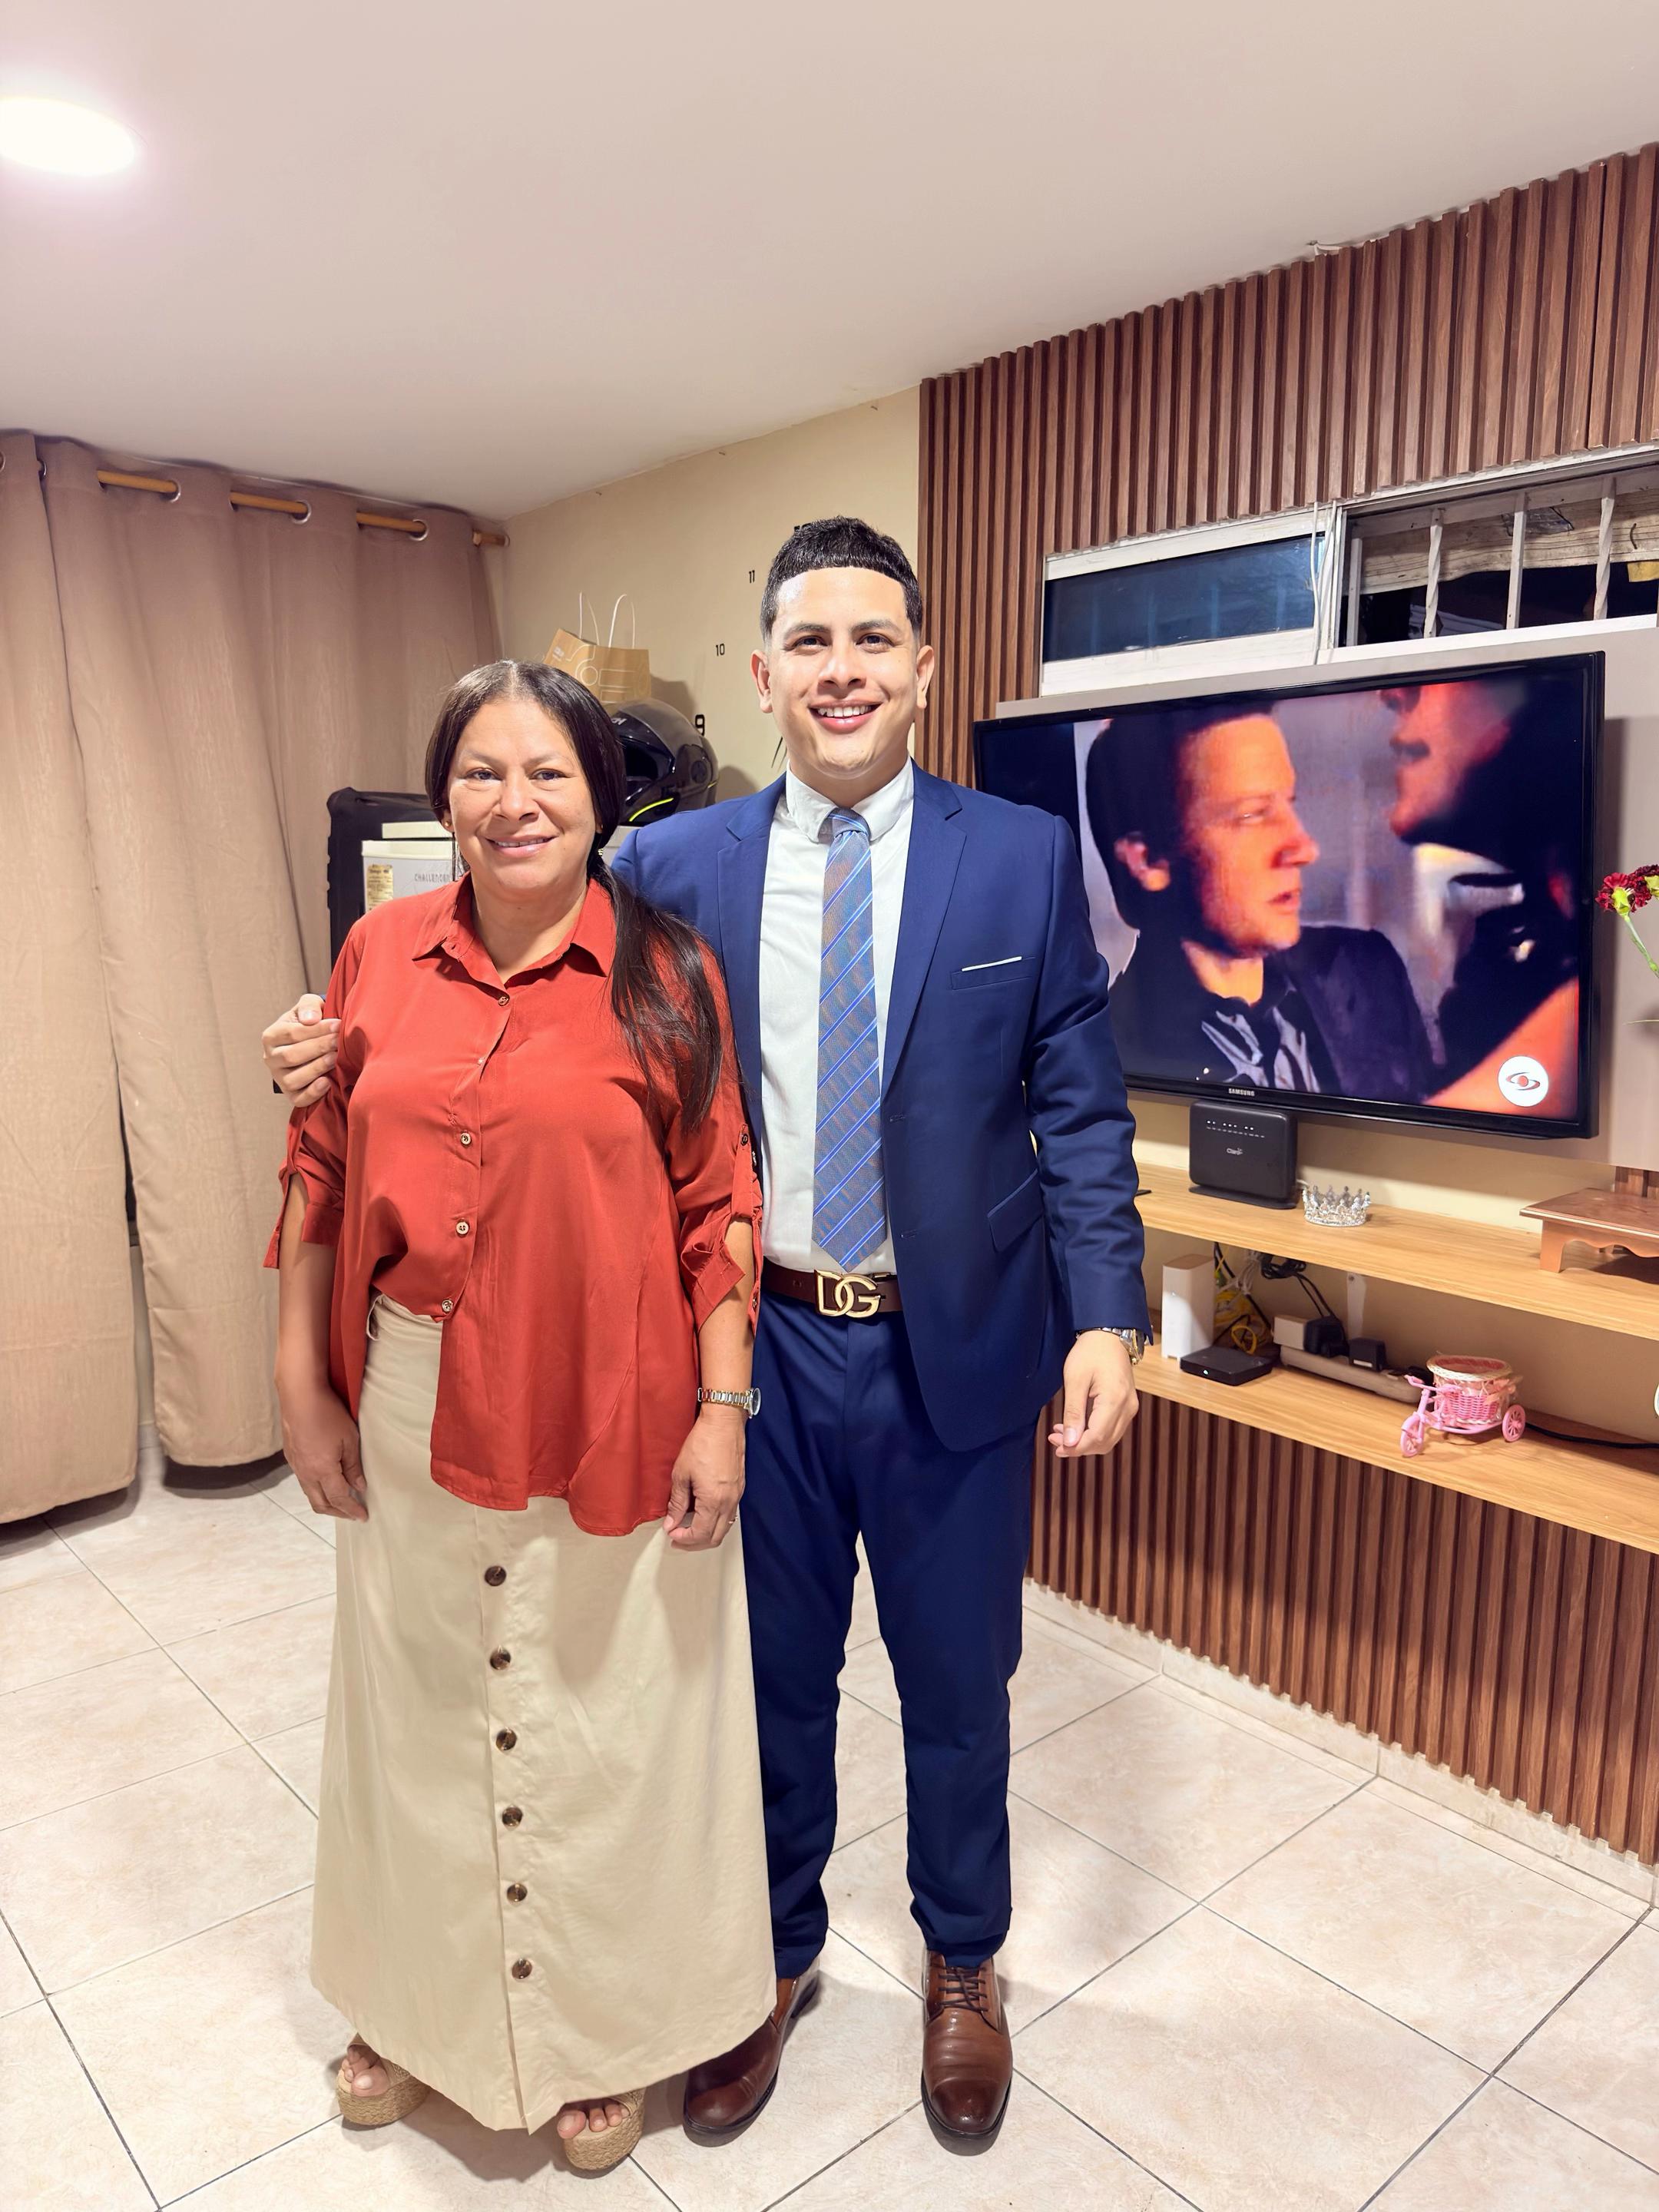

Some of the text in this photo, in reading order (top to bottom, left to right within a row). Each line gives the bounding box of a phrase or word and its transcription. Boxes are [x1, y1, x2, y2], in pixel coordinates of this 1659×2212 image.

[749, 569, 755, 584] 11
[716, 643, 725, 657] 10
[695, 714, 705, 737] 9
[816, 1270, 881, 1319] DG
